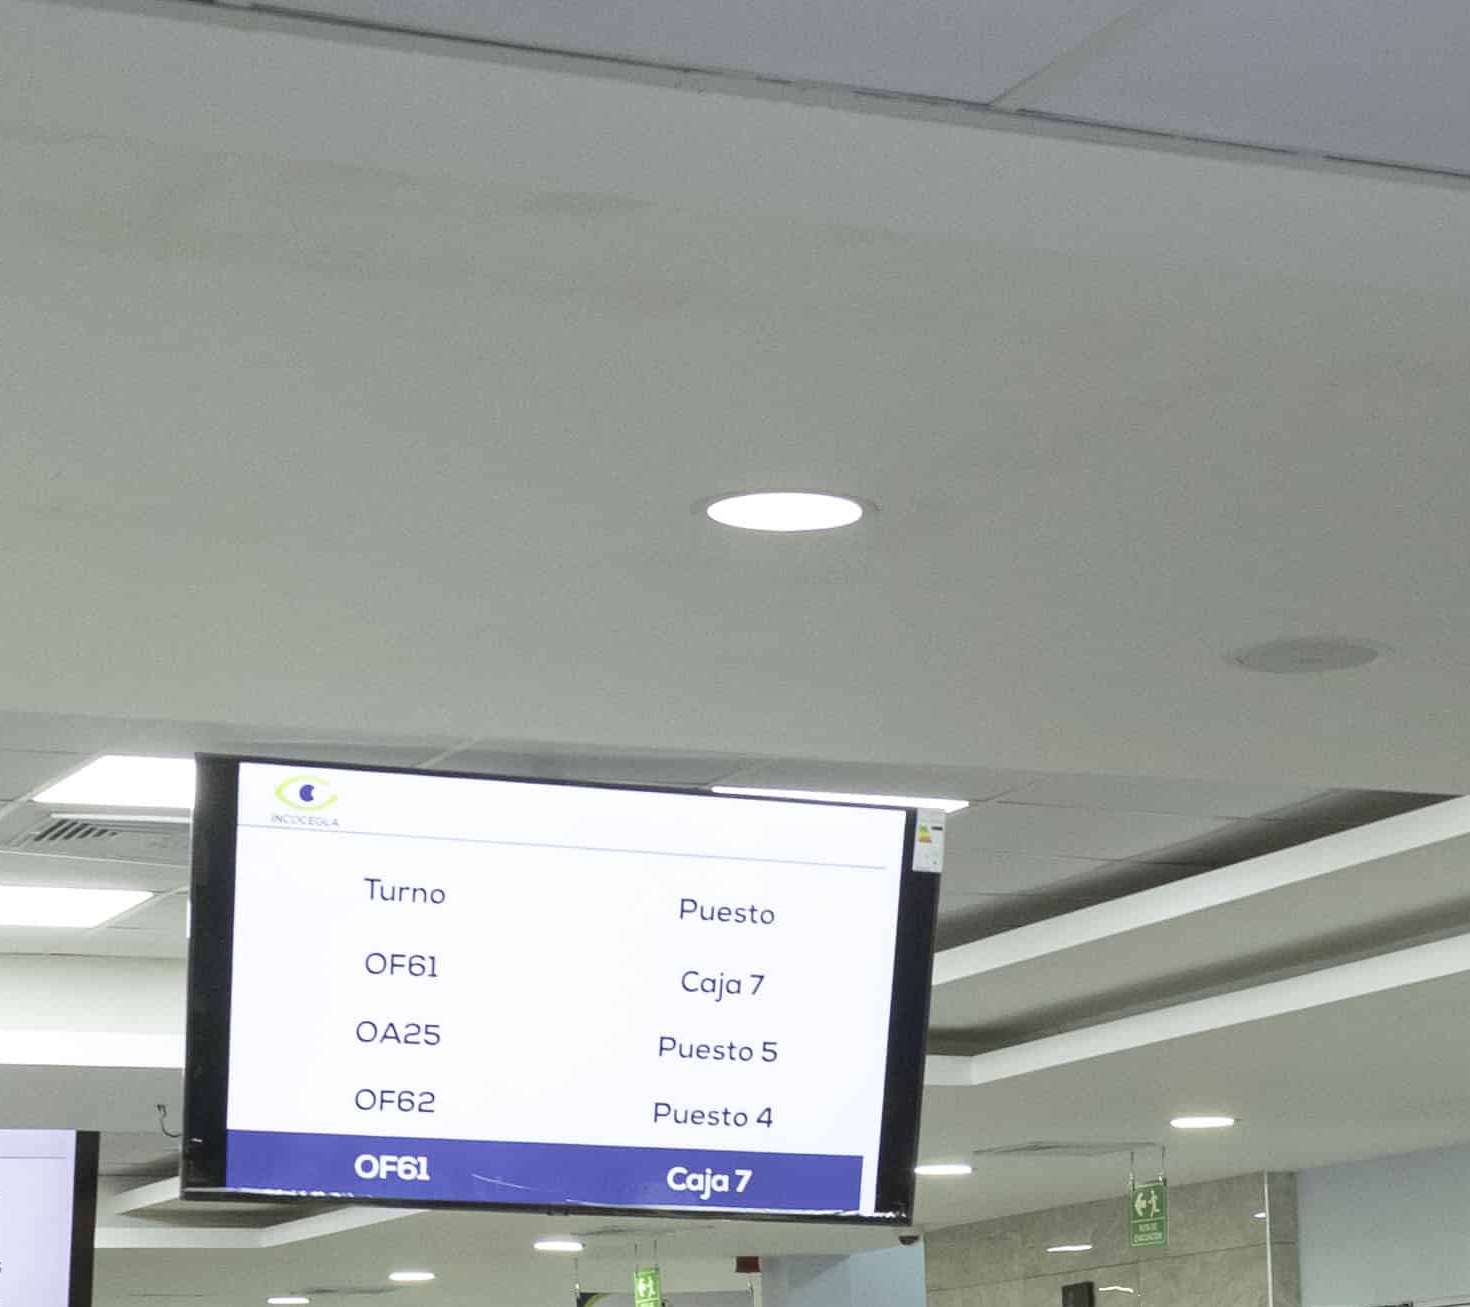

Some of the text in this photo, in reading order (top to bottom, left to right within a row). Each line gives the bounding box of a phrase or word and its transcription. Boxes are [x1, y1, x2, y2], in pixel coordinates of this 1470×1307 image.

[363, 877, 447, 905] Turno
[679, 898, 776, 926] Puesto
[364, 952, 439, 978] OF61
[681, 970, 766, 1003] Caja 7
[355, 1020, 442, 1046] OA25
[657, 1035, 779, 1063] Puesto 5
[354, 1088, 437, 1114] OF62
[653, 1101, 774, 1129] Puesto 4
[353, 1153, 432, 1182] OF61
[665, 1166, 754, 1201] Caja 7
